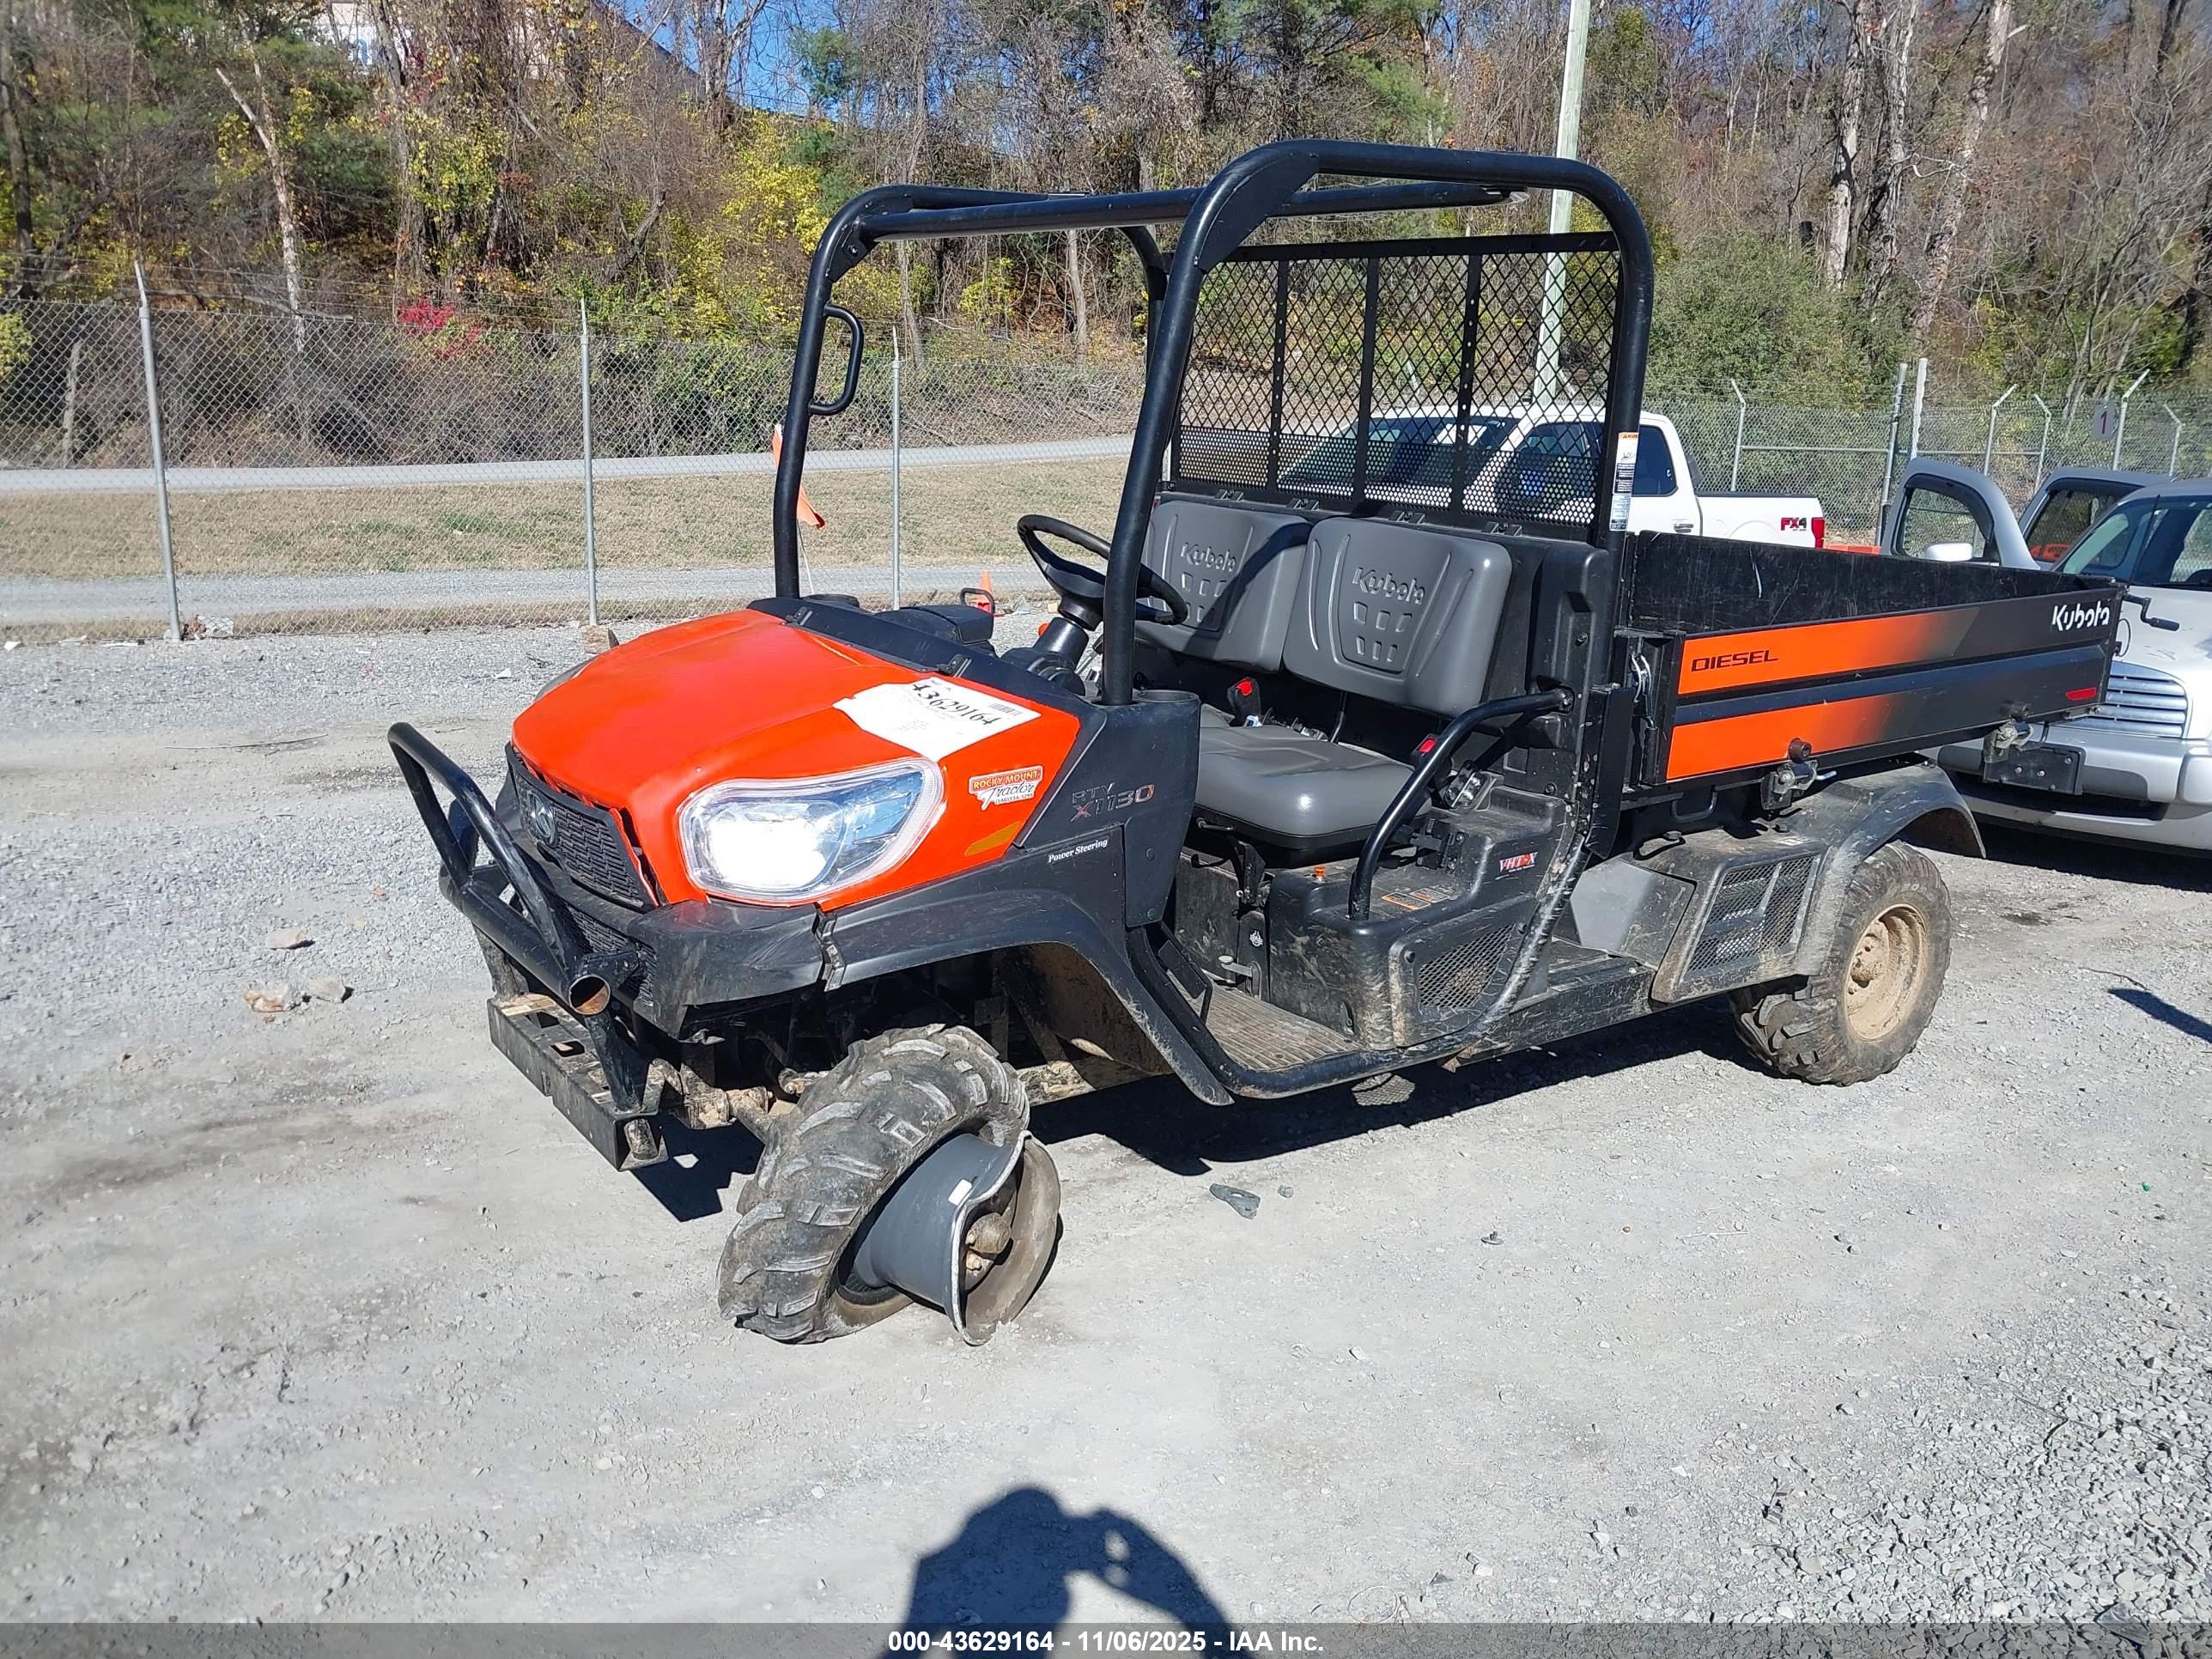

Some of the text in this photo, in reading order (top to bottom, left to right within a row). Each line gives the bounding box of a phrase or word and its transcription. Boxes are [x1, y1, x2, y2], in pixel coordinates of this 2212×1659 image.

[2100, 410, 2107, 434] 1
[1780, 517, 1807, 531] FX4
[1181, 542, 1237, 572] Kubota
[1352, 567, 1425, 605] Kubota
[2051, 600, 2111, 631] Kubota
[1691, 649, 1779, 672] DIESEL
[912, 684, 1002, 726] 43629164
[973, 770, 1039, 790] ROCKY MOUNT
[980, 780, 1036, 808] Tractor
[1070, 784, 1155, 823] X1130
[1072, 782, 1115, 805] RTY
[1048, 839, 1109, 864] Power Steering
